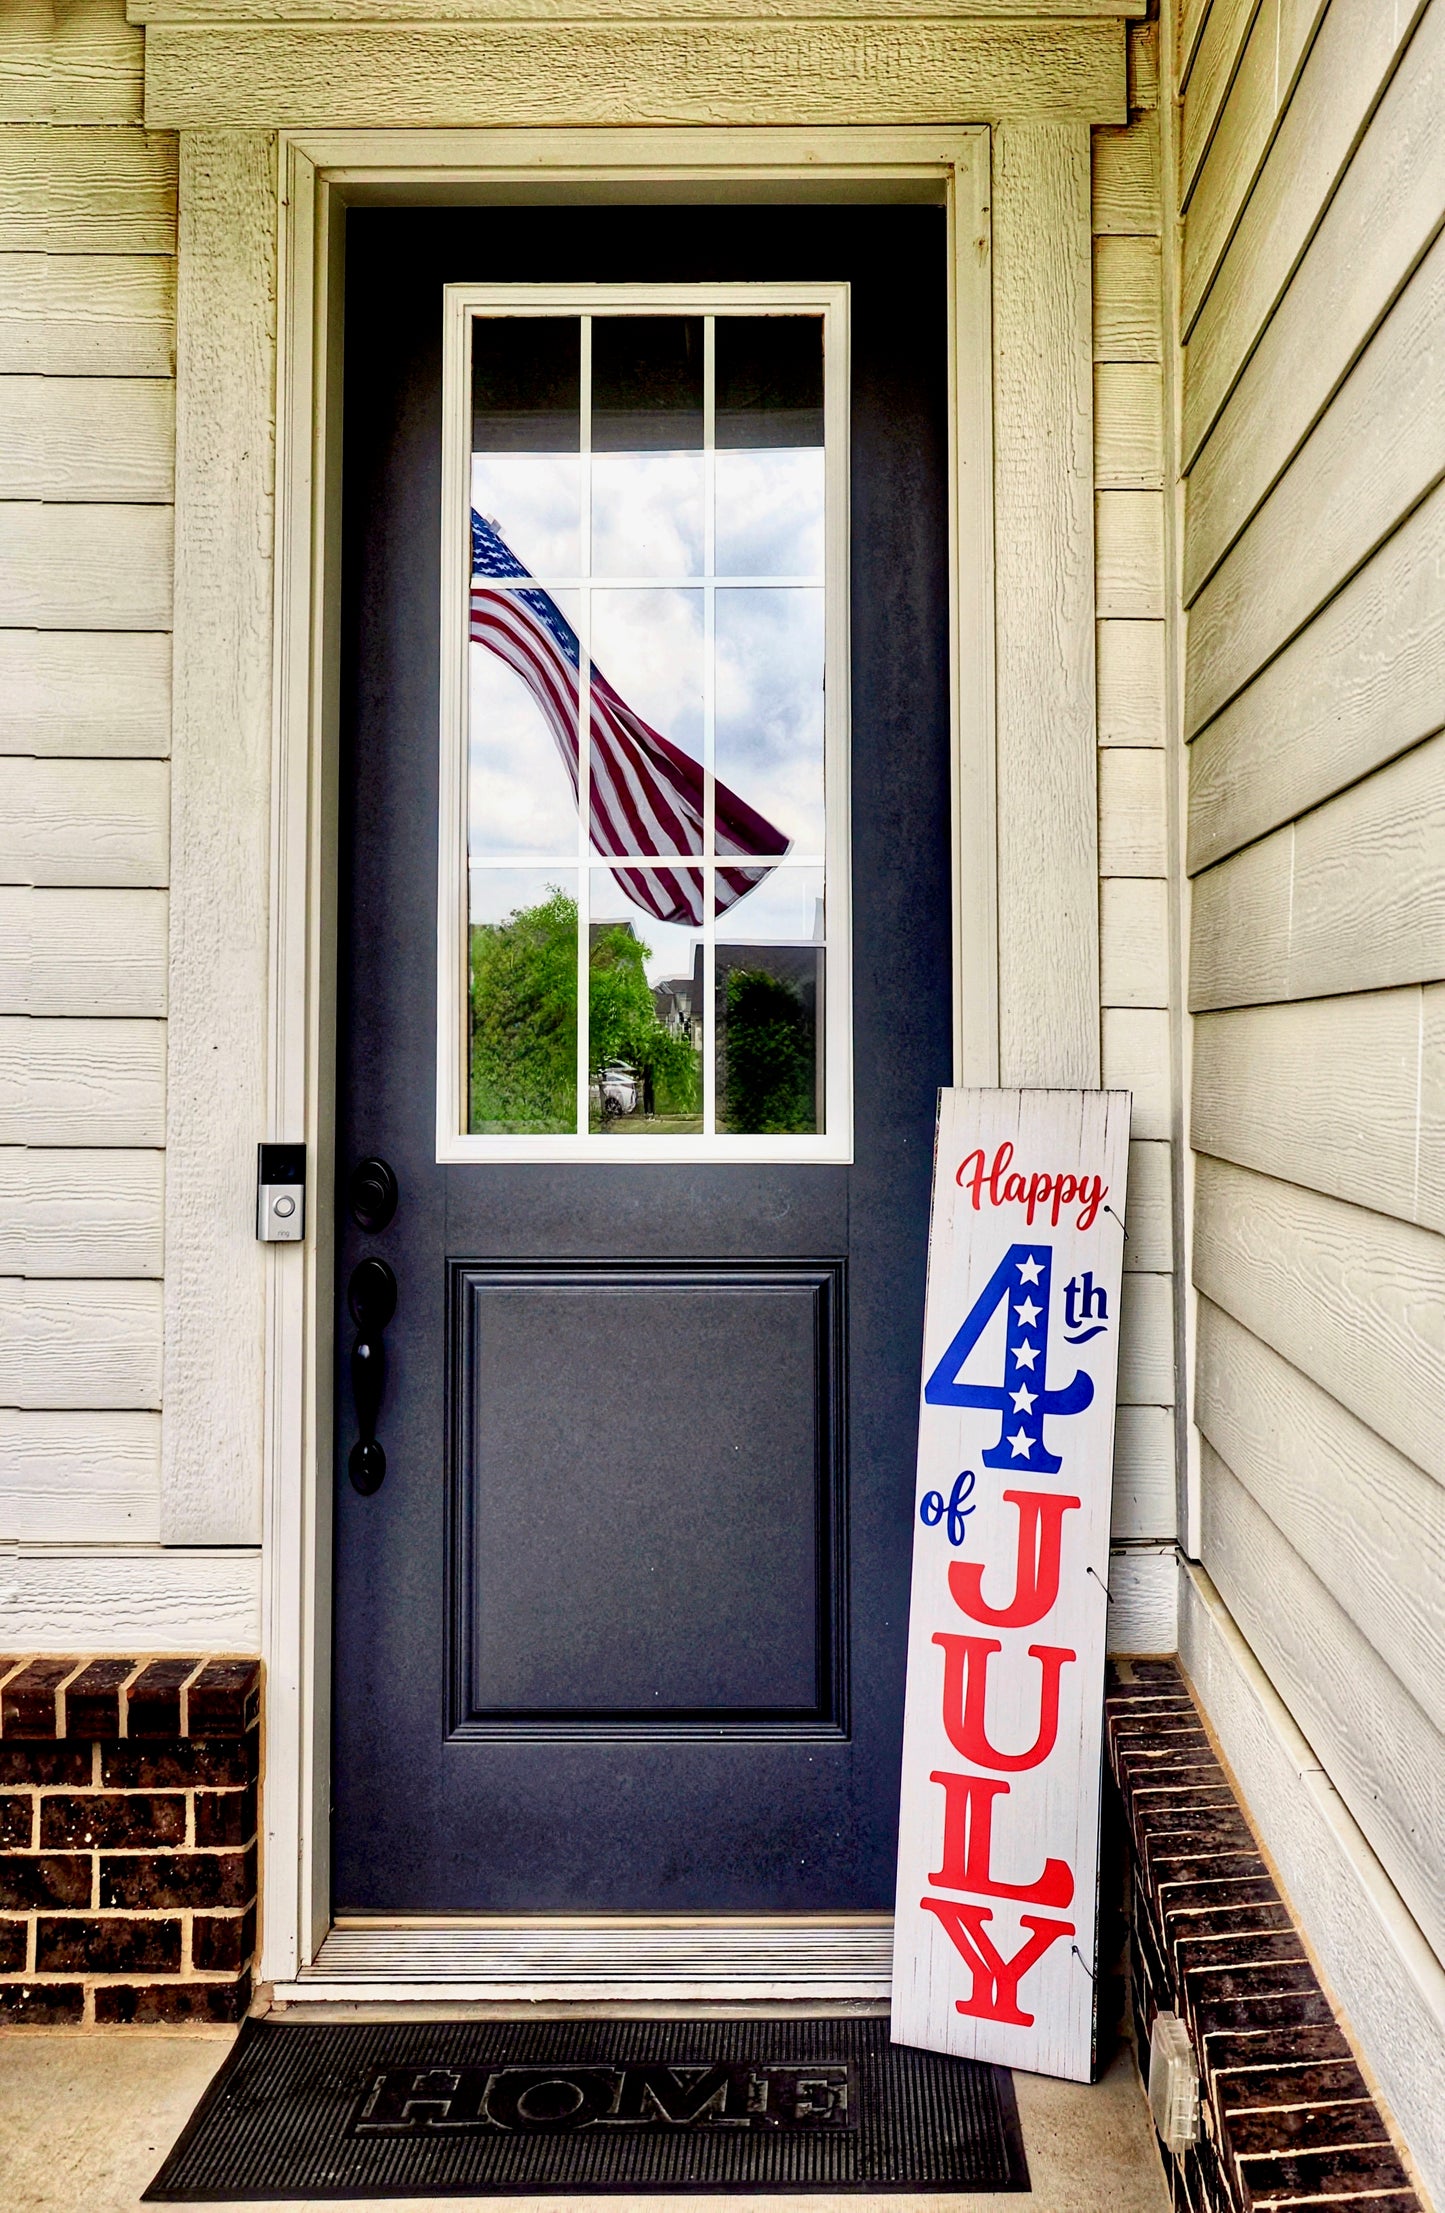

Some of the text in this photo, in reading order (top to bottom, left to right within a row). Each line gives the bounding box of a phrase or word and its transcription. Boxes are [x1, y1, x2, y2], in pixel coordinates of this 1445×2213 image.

[955, 1141, 1108, 1231] Happy
[924, 1243, 1108, 1475] 4th
[919, 1469, 976, 1547] of
[919, 1489, 1081, 2027] JULY
[355, 2064, 851, 2132] HOME
